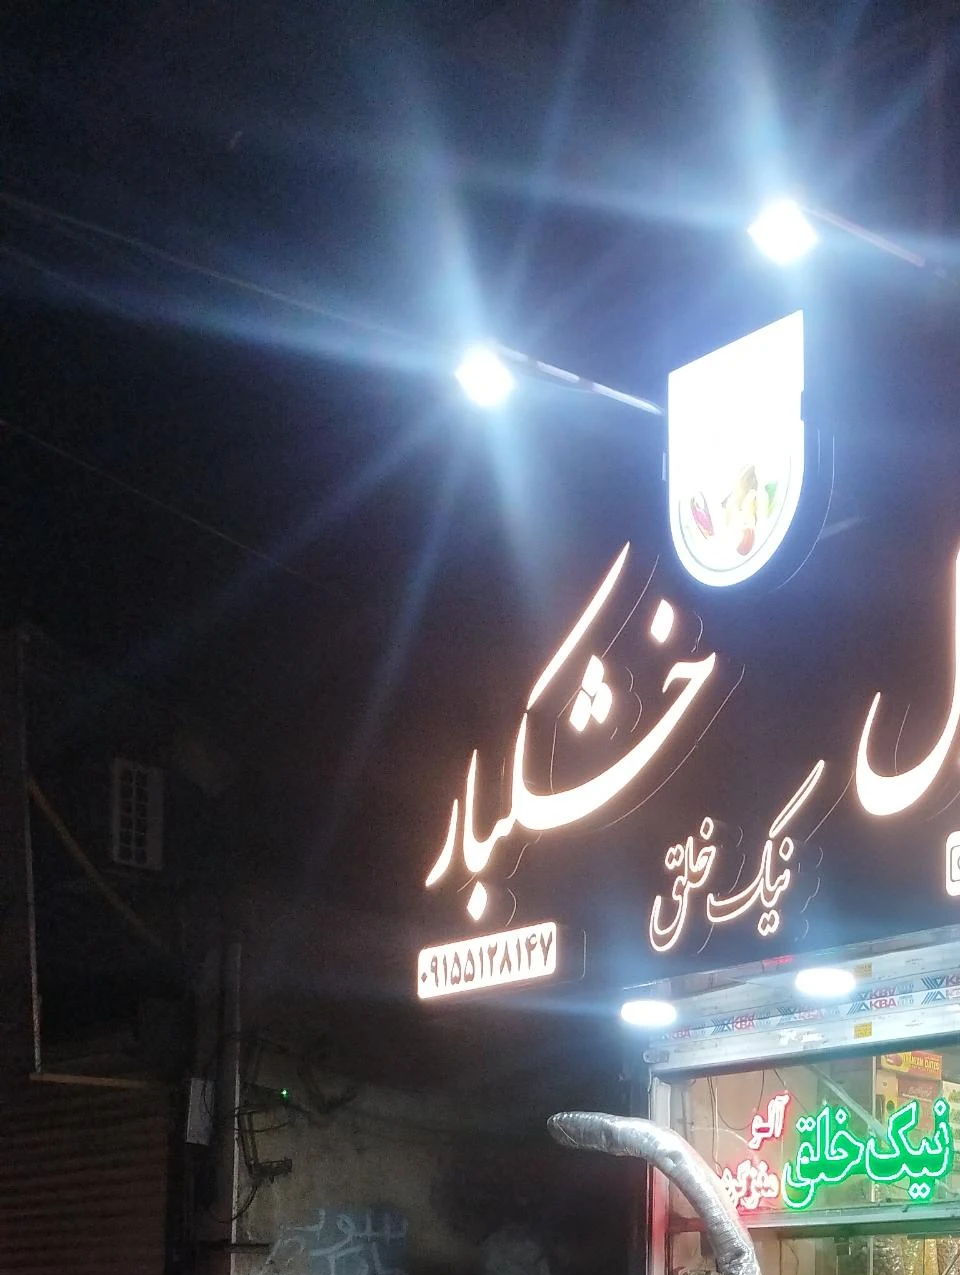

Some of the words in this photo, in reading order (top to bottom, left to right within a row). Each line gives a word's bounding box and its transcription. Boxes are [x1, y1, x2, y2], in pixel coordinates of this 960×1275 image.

[424, 541, 717, 921] خشکبار
[649, 817, 717, 952] خلق
[707, 759, 825, 937] نیک
[420, 930, 553, 988] ۰۹۱۵۵۱۲۸۱۴۷
[782, 1104, 866, 1209] خلق
[866, 1098, 951, 1201] نیک
